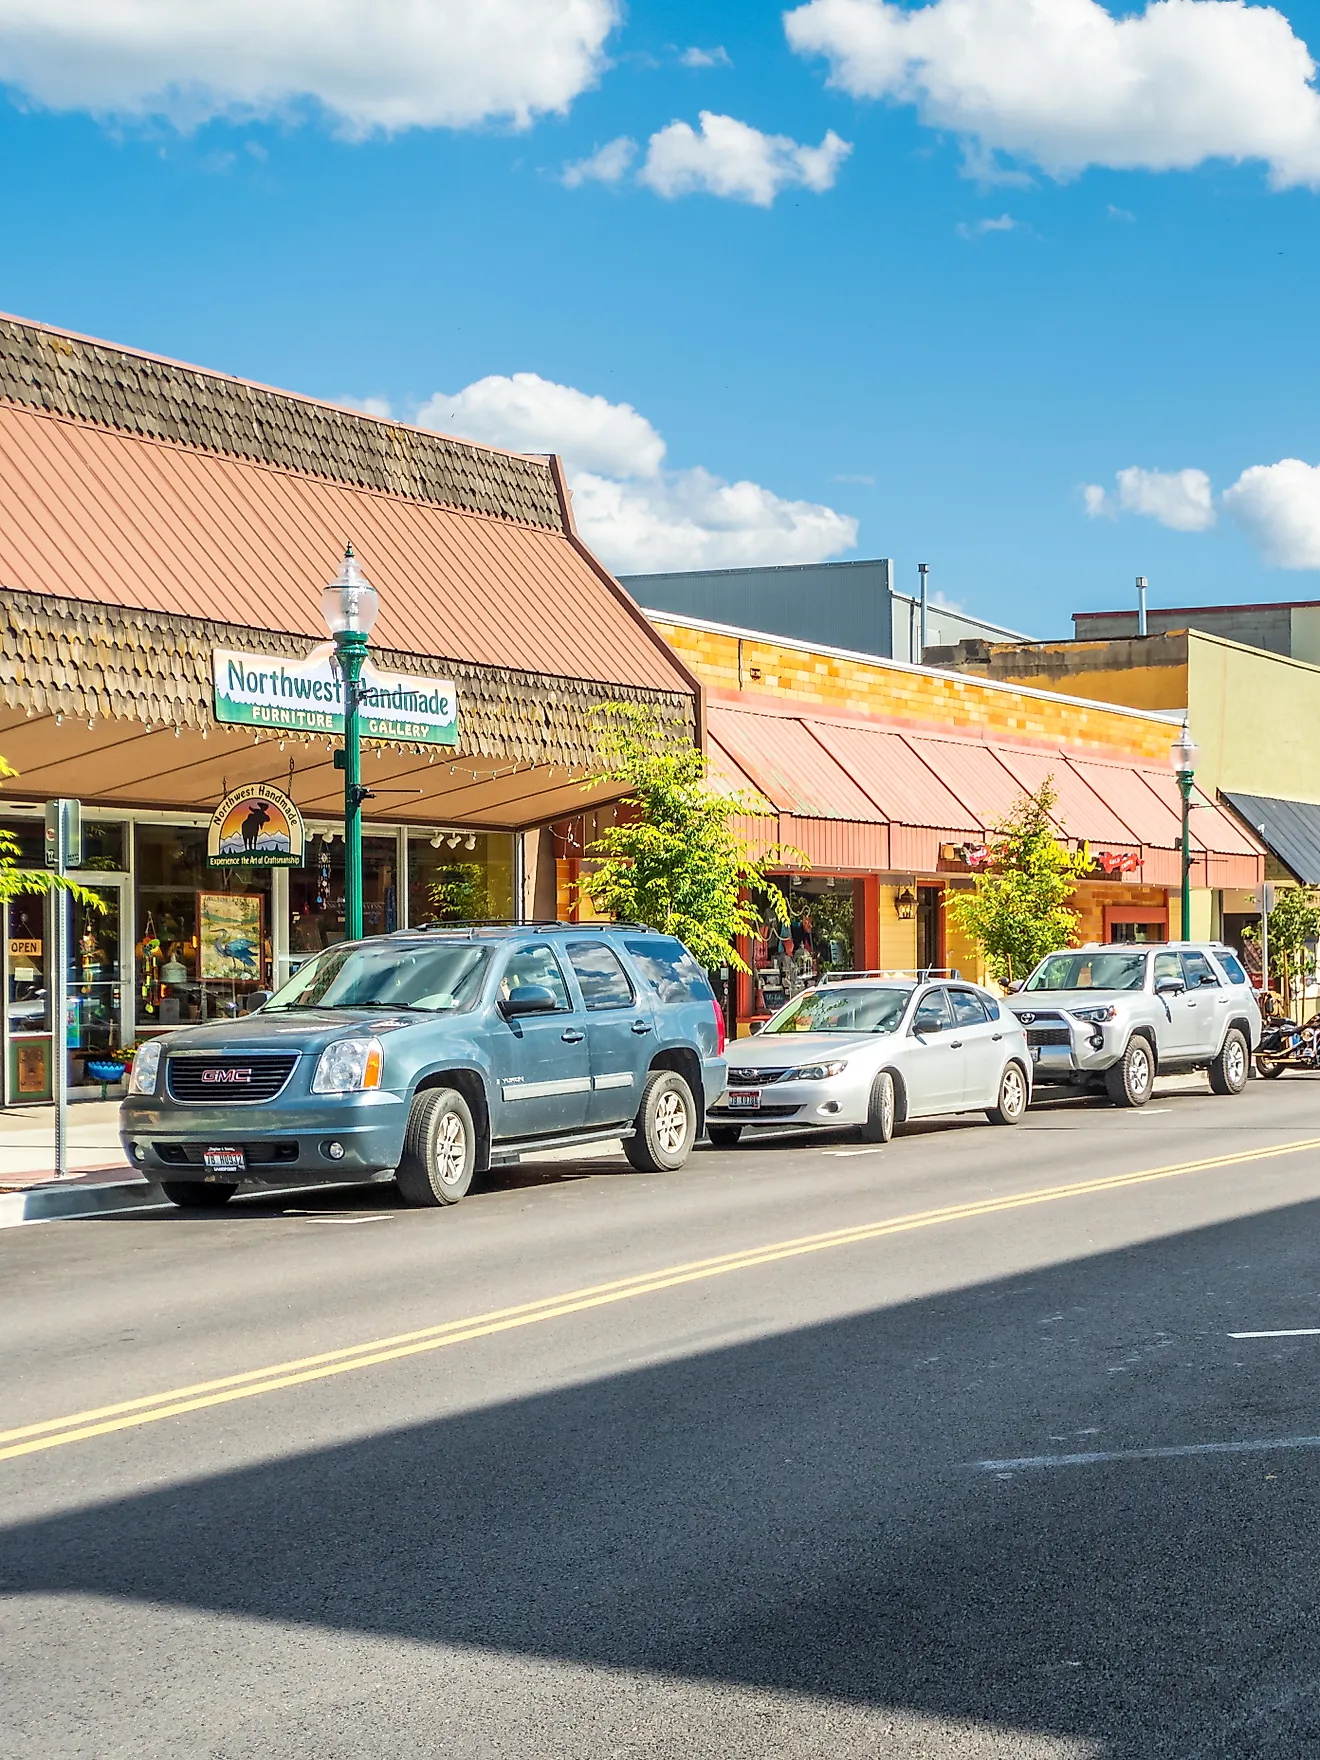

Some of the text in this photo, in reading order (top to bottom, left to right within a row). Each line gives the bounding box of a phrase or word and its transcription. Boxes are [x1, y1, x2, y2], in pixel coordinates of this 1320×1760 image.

[227, 659, 342, 704] Northwest
[252, 706, 333, 728] FURNITURE
[368, 719, 430, 738] GALLERY
[213, 785, 298, 827] Northwest Handmade
[209, 856, 240, 867] Experience
[241, 856, 249, 865] the
[249, 856, 258, 865] Art
[11, 942, 38, 953] OPEN
[202, 1068, 252, 1083] GMC
